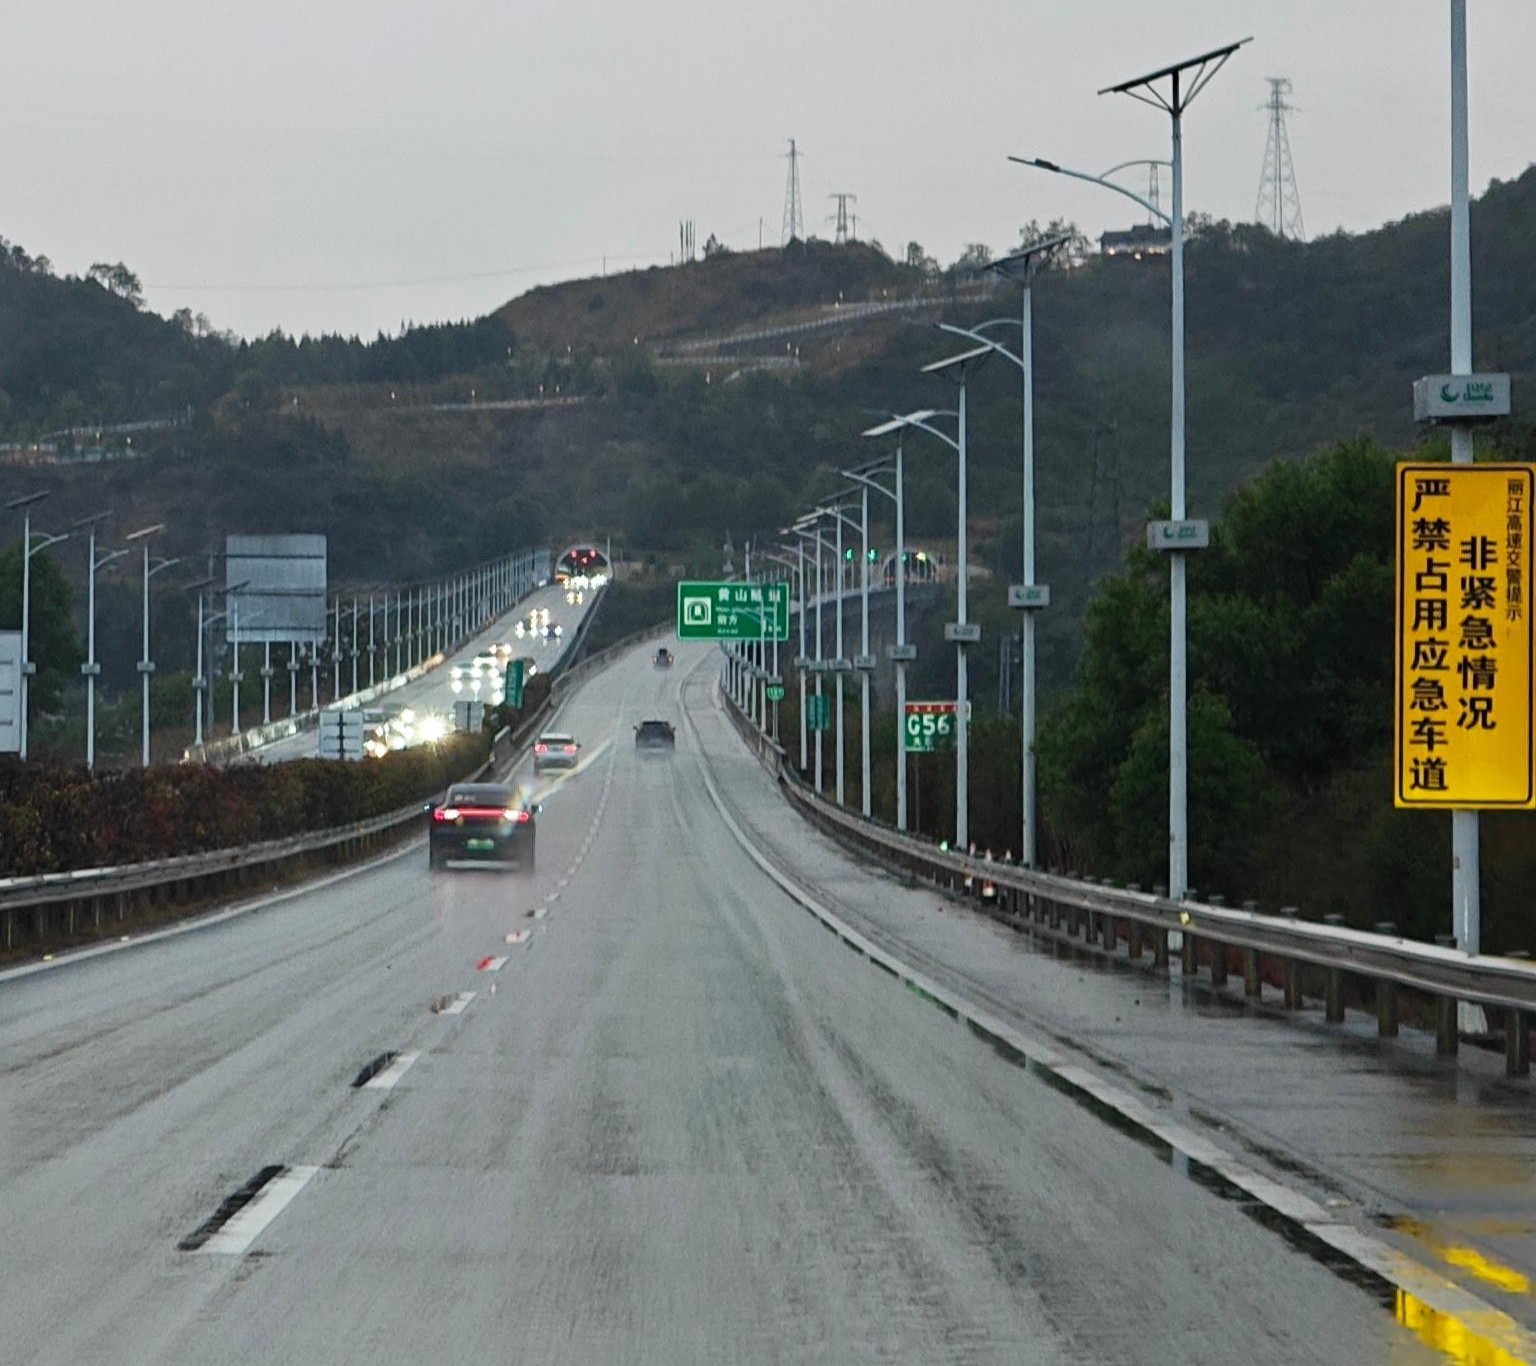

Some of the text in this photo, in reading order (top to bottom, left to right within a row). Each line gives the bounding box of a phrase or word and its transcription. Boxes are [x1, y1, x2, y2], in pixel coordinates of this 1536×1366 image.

[1409, 478, 1451, 791] 严禁占用应急车道
[1456, 536, 1498, 730] 非紧急情况
